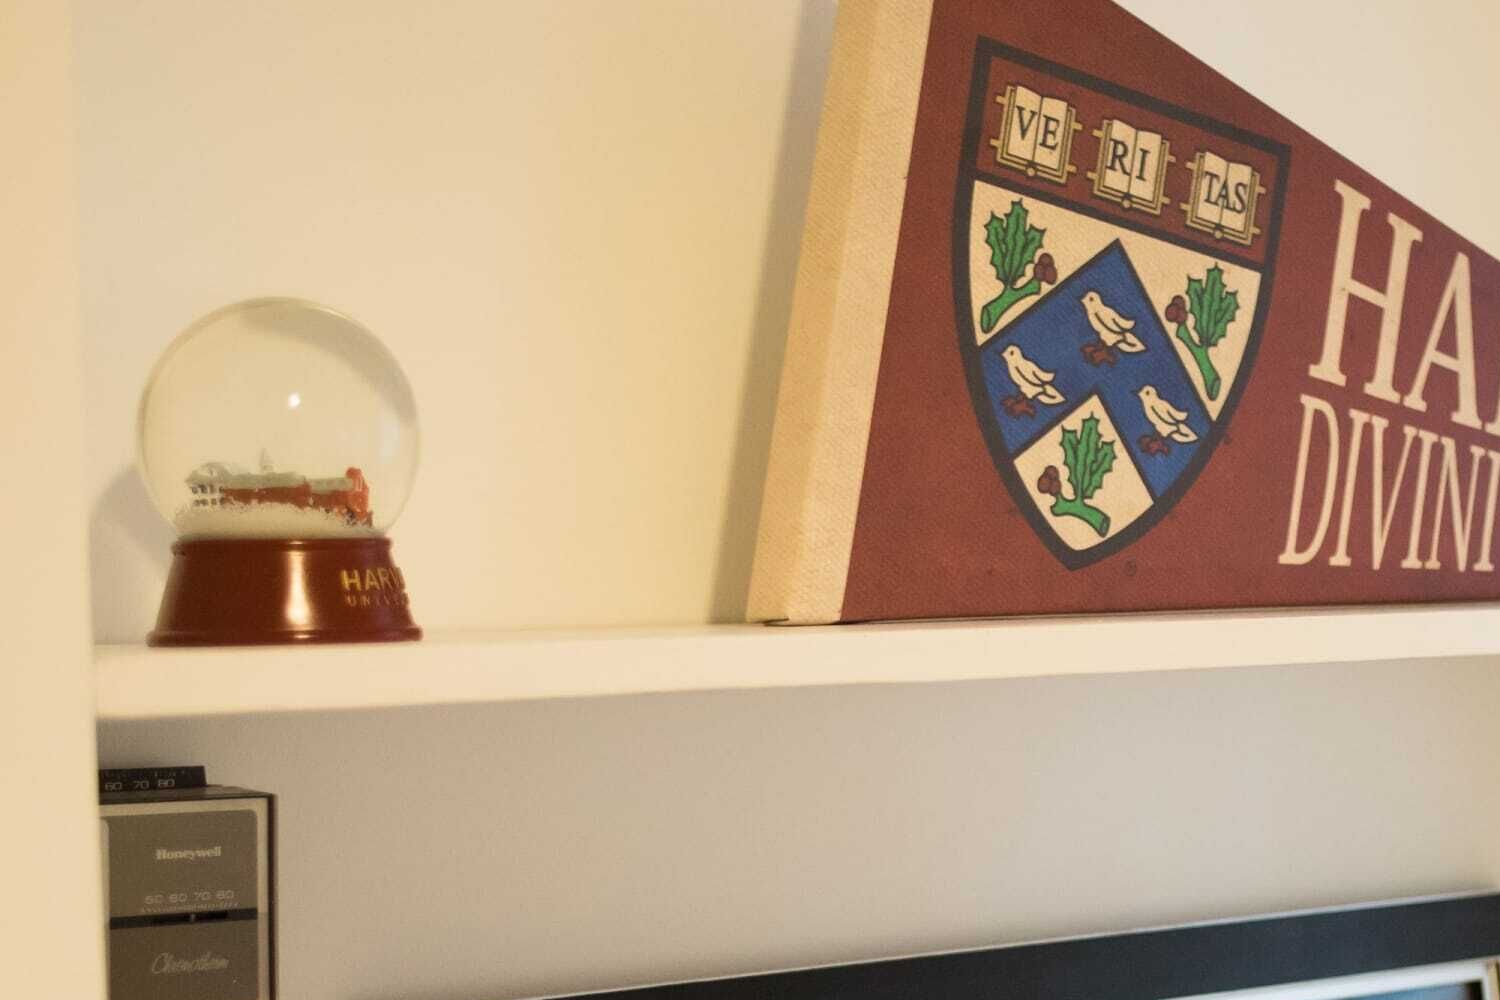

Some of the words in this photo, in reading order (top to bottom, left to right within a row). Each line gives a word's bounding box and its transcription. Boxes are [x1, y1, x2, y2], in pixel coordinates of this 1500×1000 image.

[1015, 104, 1060, 151] VE
[1106, 138, 1151, 183] RI
[1203, 171, 1248, 214] TAS
